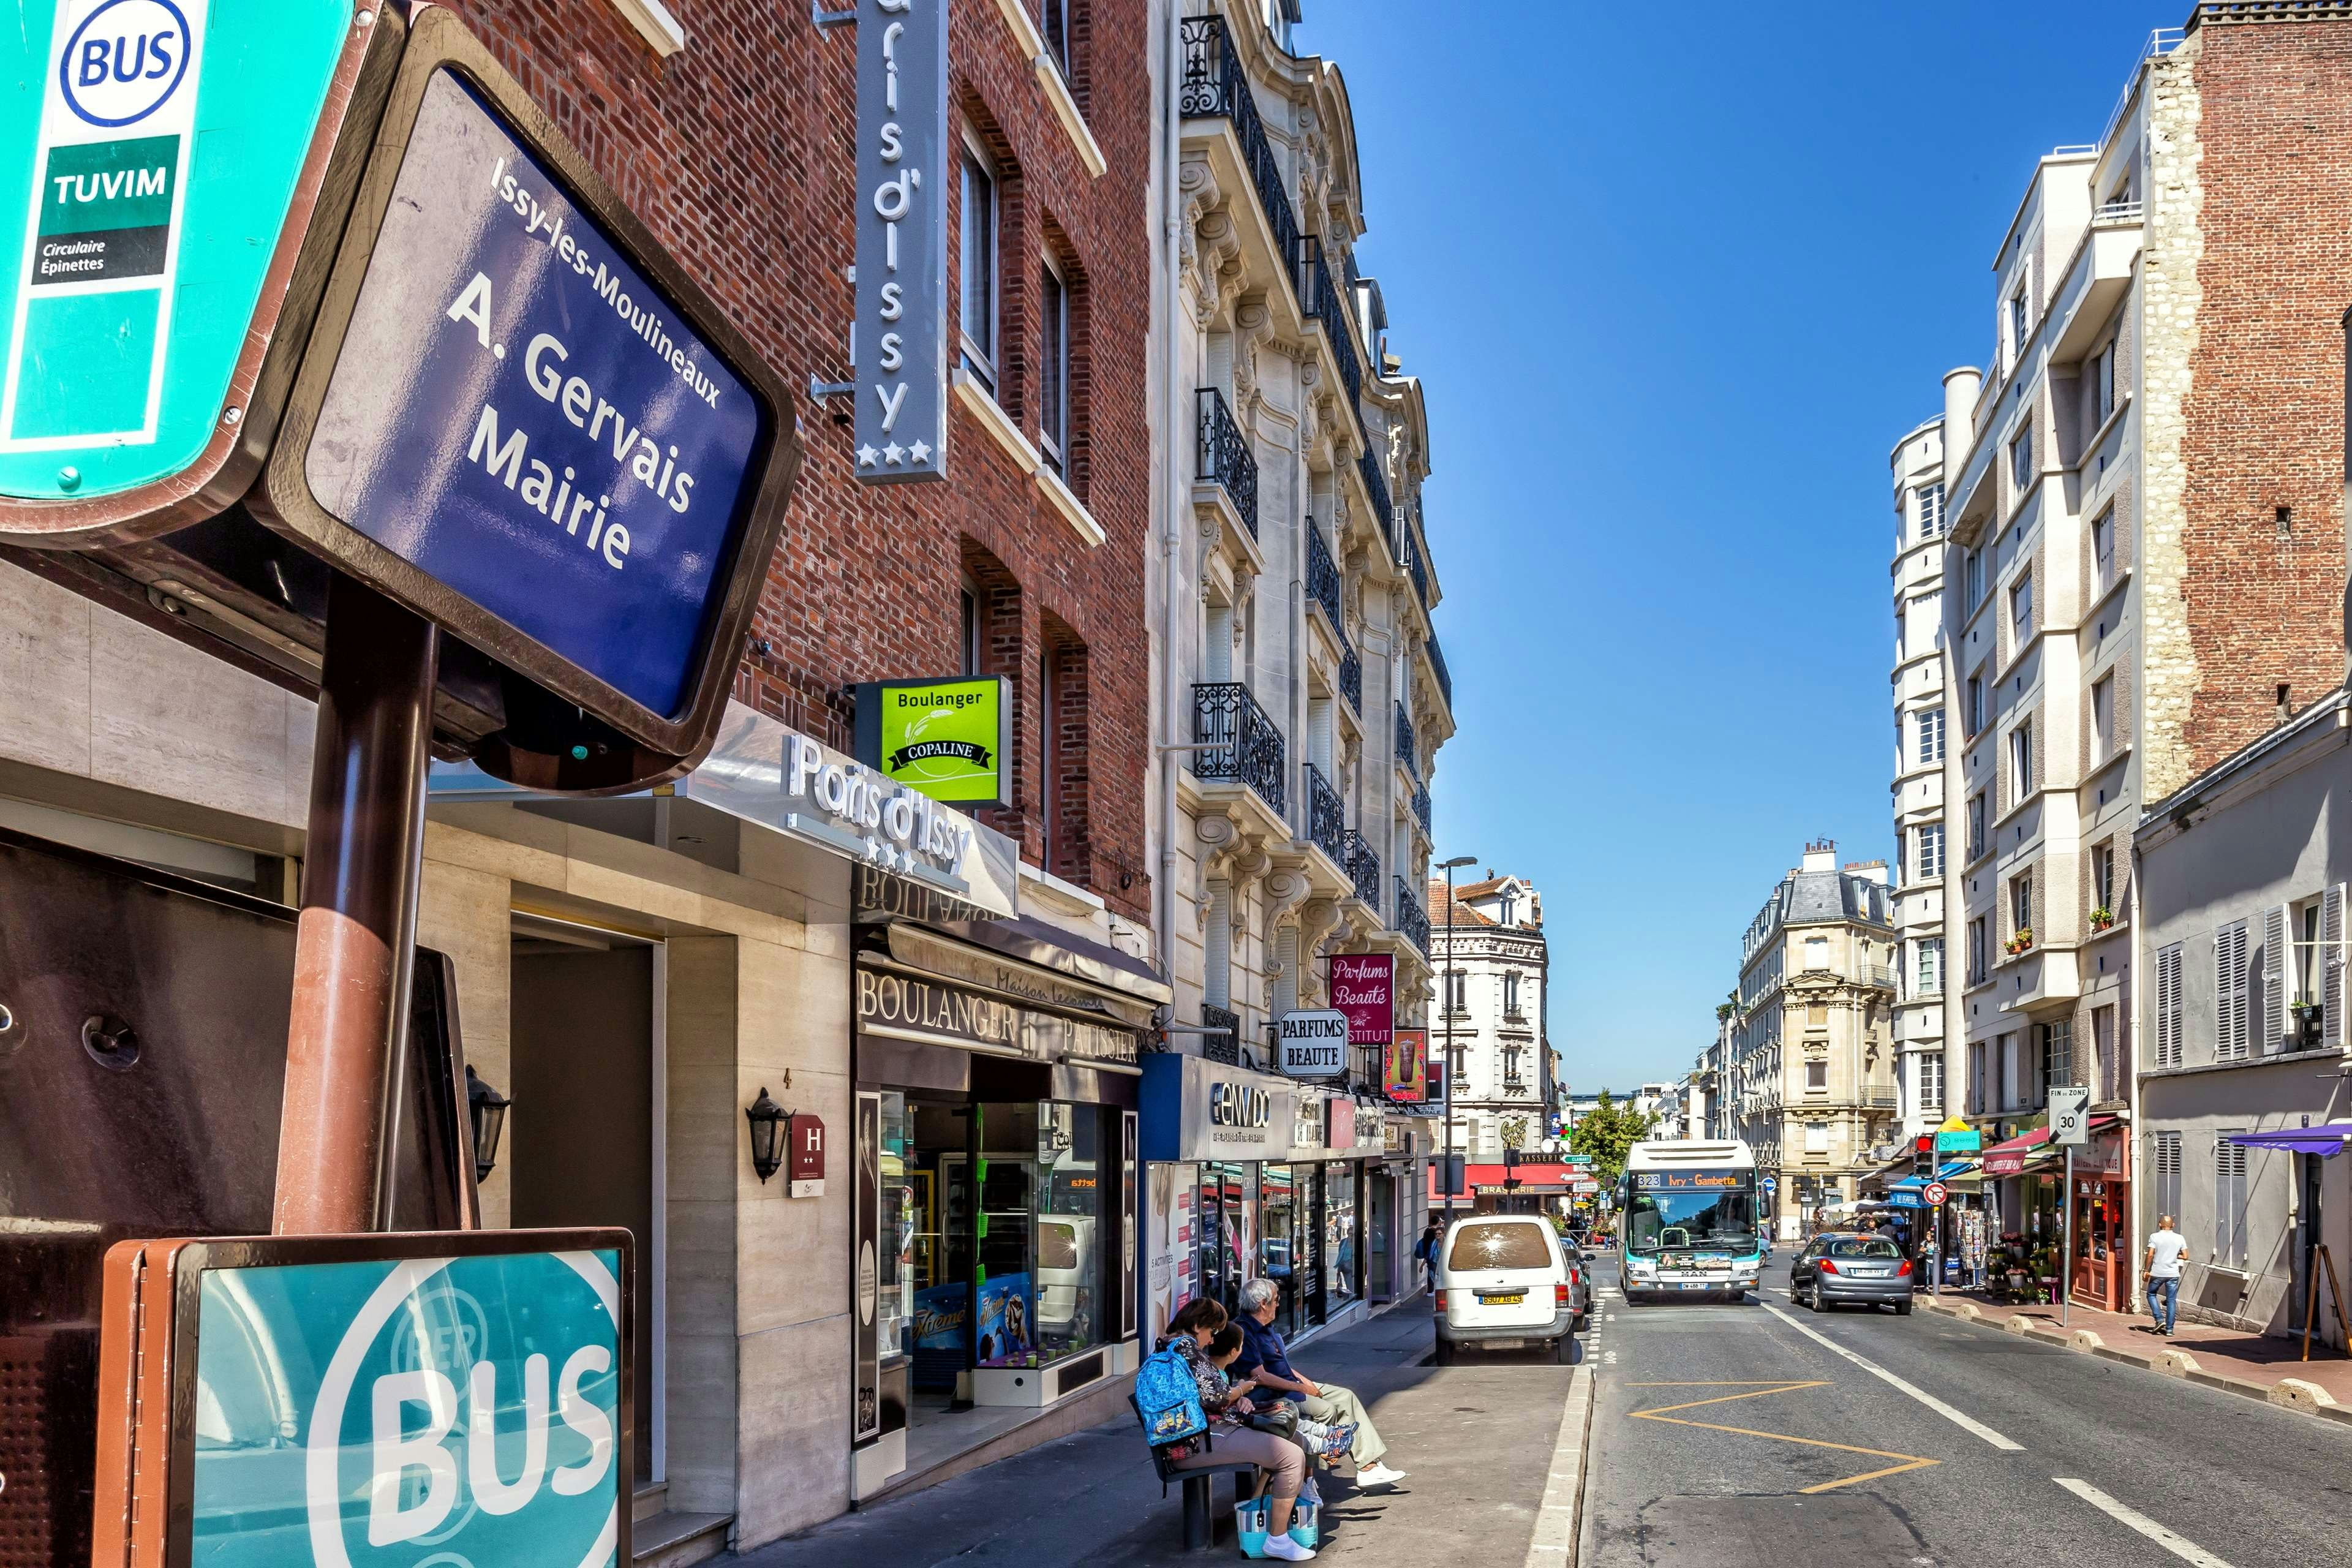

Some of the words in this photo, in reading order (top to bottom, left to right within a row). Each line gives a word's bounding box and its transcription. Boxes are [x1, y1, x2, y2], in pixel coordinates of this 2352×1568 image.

[78, 31, 175, 87] BUS
[53, 167, 166, 204] TUVIM
[42, 239, 105, 257] Circulaire
[40, 257, 104, 275] Épinettes
[490, 157, 722, 409] Issy-les-Moulineaux
[447, 271, 506, 360] A.
[524, 333, 695, 514] Gervais
[467, 404, 631, 570] Mairie
[899, 692, 982, 709] Boulanger
[908, 742, 973, 759] COPALINE
[790, 735, 881, 827] Paris
[884, 788, 971, 876] d'Issy
[1333, 959, 1389, 982] Parfums
[858, 970, 1016, 1042] BOULANGER
[1335, 986, 1387, 1005] Beauté
[1063, 1018, 1137, 1063] PATISSIER
[1282, 1020, 1344, 1038] PARFUMS
[1348, 1030, 1389, 1041] STITUT
[1287, 1047, 1338, 1066] BEAUTE
[2060, 1117, 2075, 1128] 30
[806, 1128, 821, 1151] H
[1638, 1176, 1659, 1186] 323
[1669, 1175, 1686, 1186] Ivry
[1695, 1174, 1736, 1186] Gambetta
[368, 1344, 611, 1548] BUS
